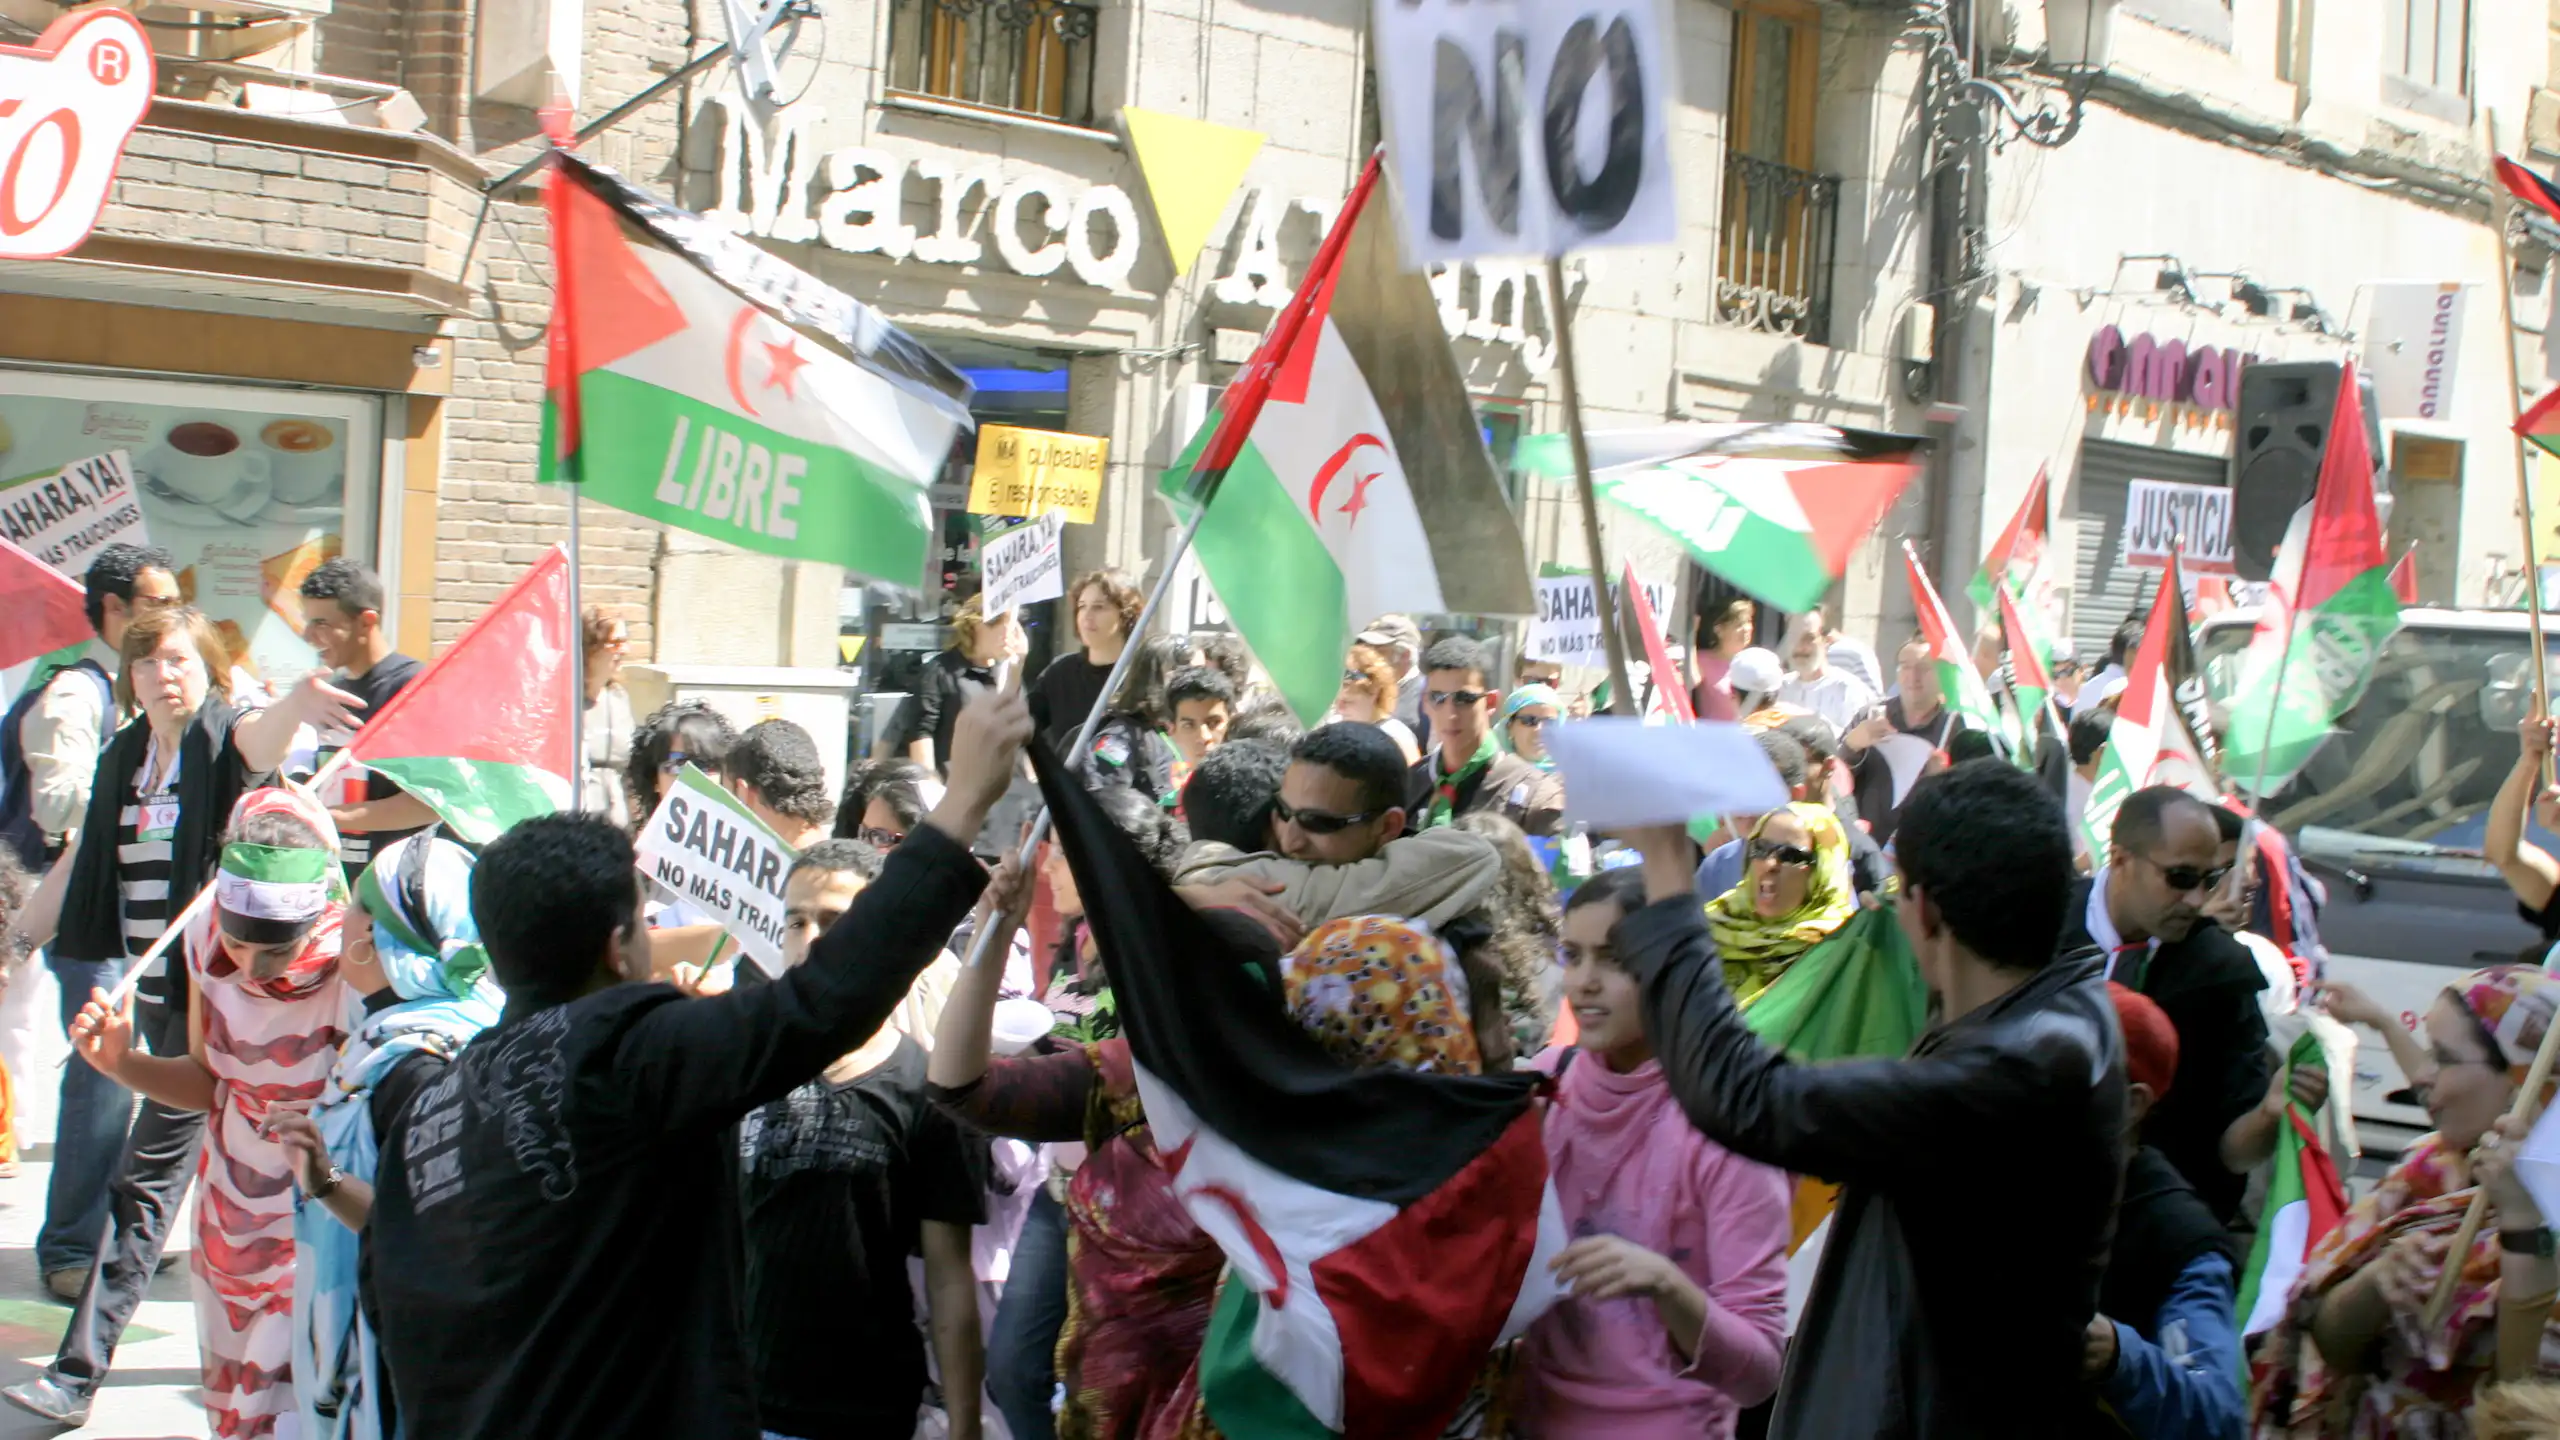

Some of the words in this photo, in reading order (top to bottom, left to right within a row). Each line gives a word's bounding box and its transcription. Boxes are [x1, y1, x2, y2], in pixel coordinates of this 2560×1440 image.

[700, 93, 1139, 288] Marco
[1430, 14, 1644, 242] NO
[655, 414, 808, 541] LIBRE
[657, 857, 685, 888] NO
[690, 873, 733, 911] MÁS
